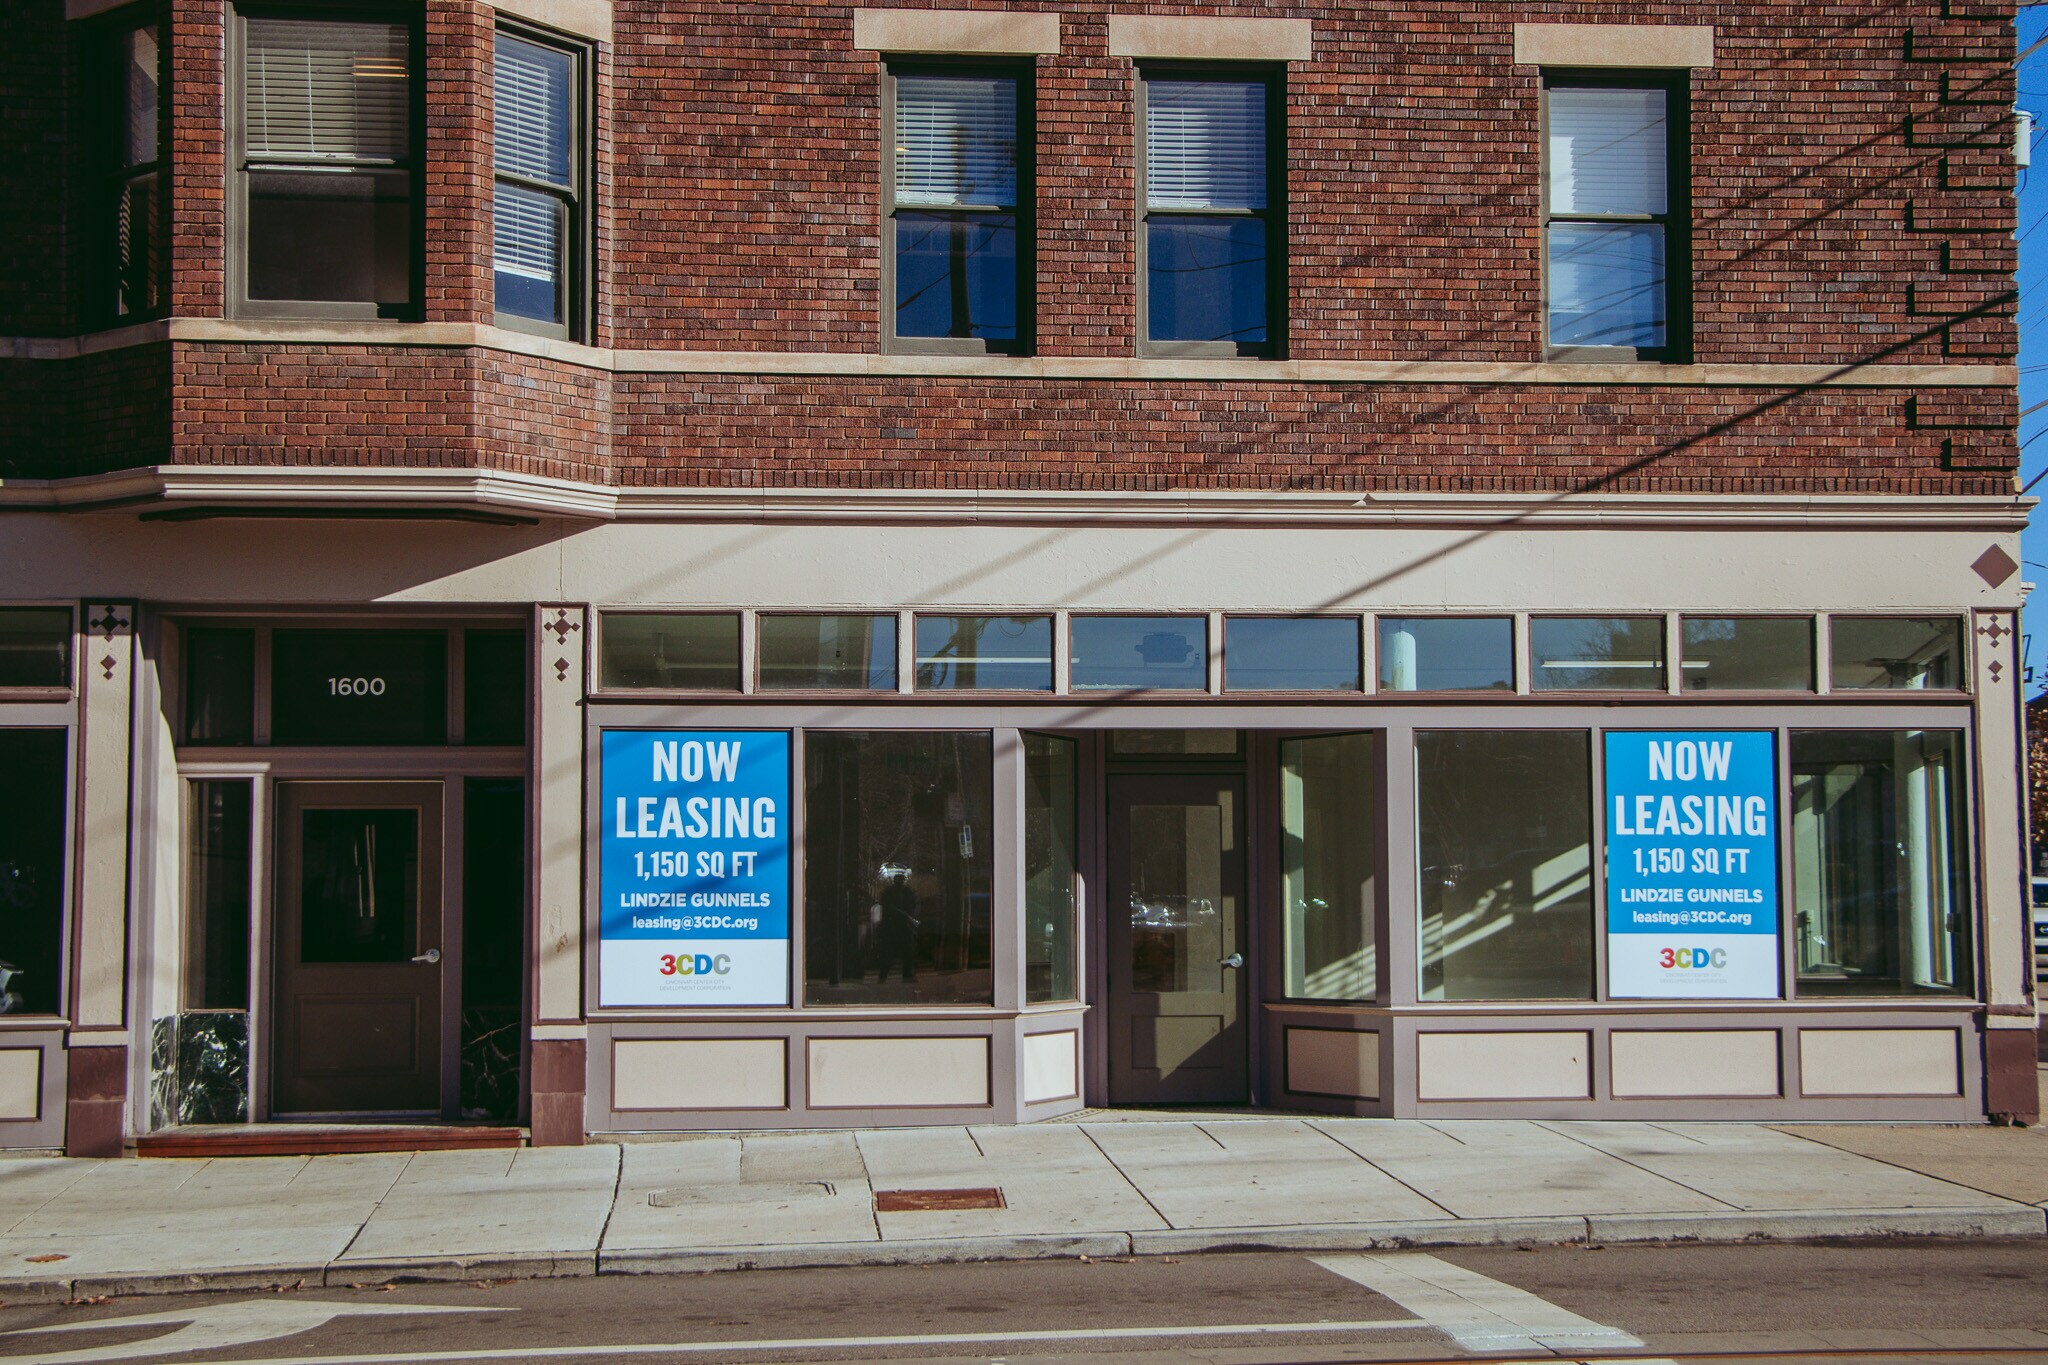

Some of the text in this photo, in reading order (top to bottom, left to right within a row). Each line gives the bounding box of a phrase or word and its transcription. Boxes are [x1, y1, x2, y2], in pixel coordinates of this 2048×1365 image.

[328, 677, 386, 696] 1600
[653, 740, 742, 783] NOW
[1648, 740, 1733, 781] NOW
[616, 796, 776, 839] LEASING
[1615, 795, 1767, 837] LEASING
[634, 850, 758, 881] 1,150 SQ FT
[1633, 847, 1751, 877] 1,150 SQ FT
[620, 892, 771, 908] LINDZIE GUNNELS
[1621, 888, 1763, 903] LINDZIE GUNNELS
[632, 915, 758, 931] leasing@3CDC.org
[1633, 910, 1752, 926] leasing@3CDC.org
[659, 954, 731, 975] 3CDC
[1659, 947, 1727, 969] 3CDC
